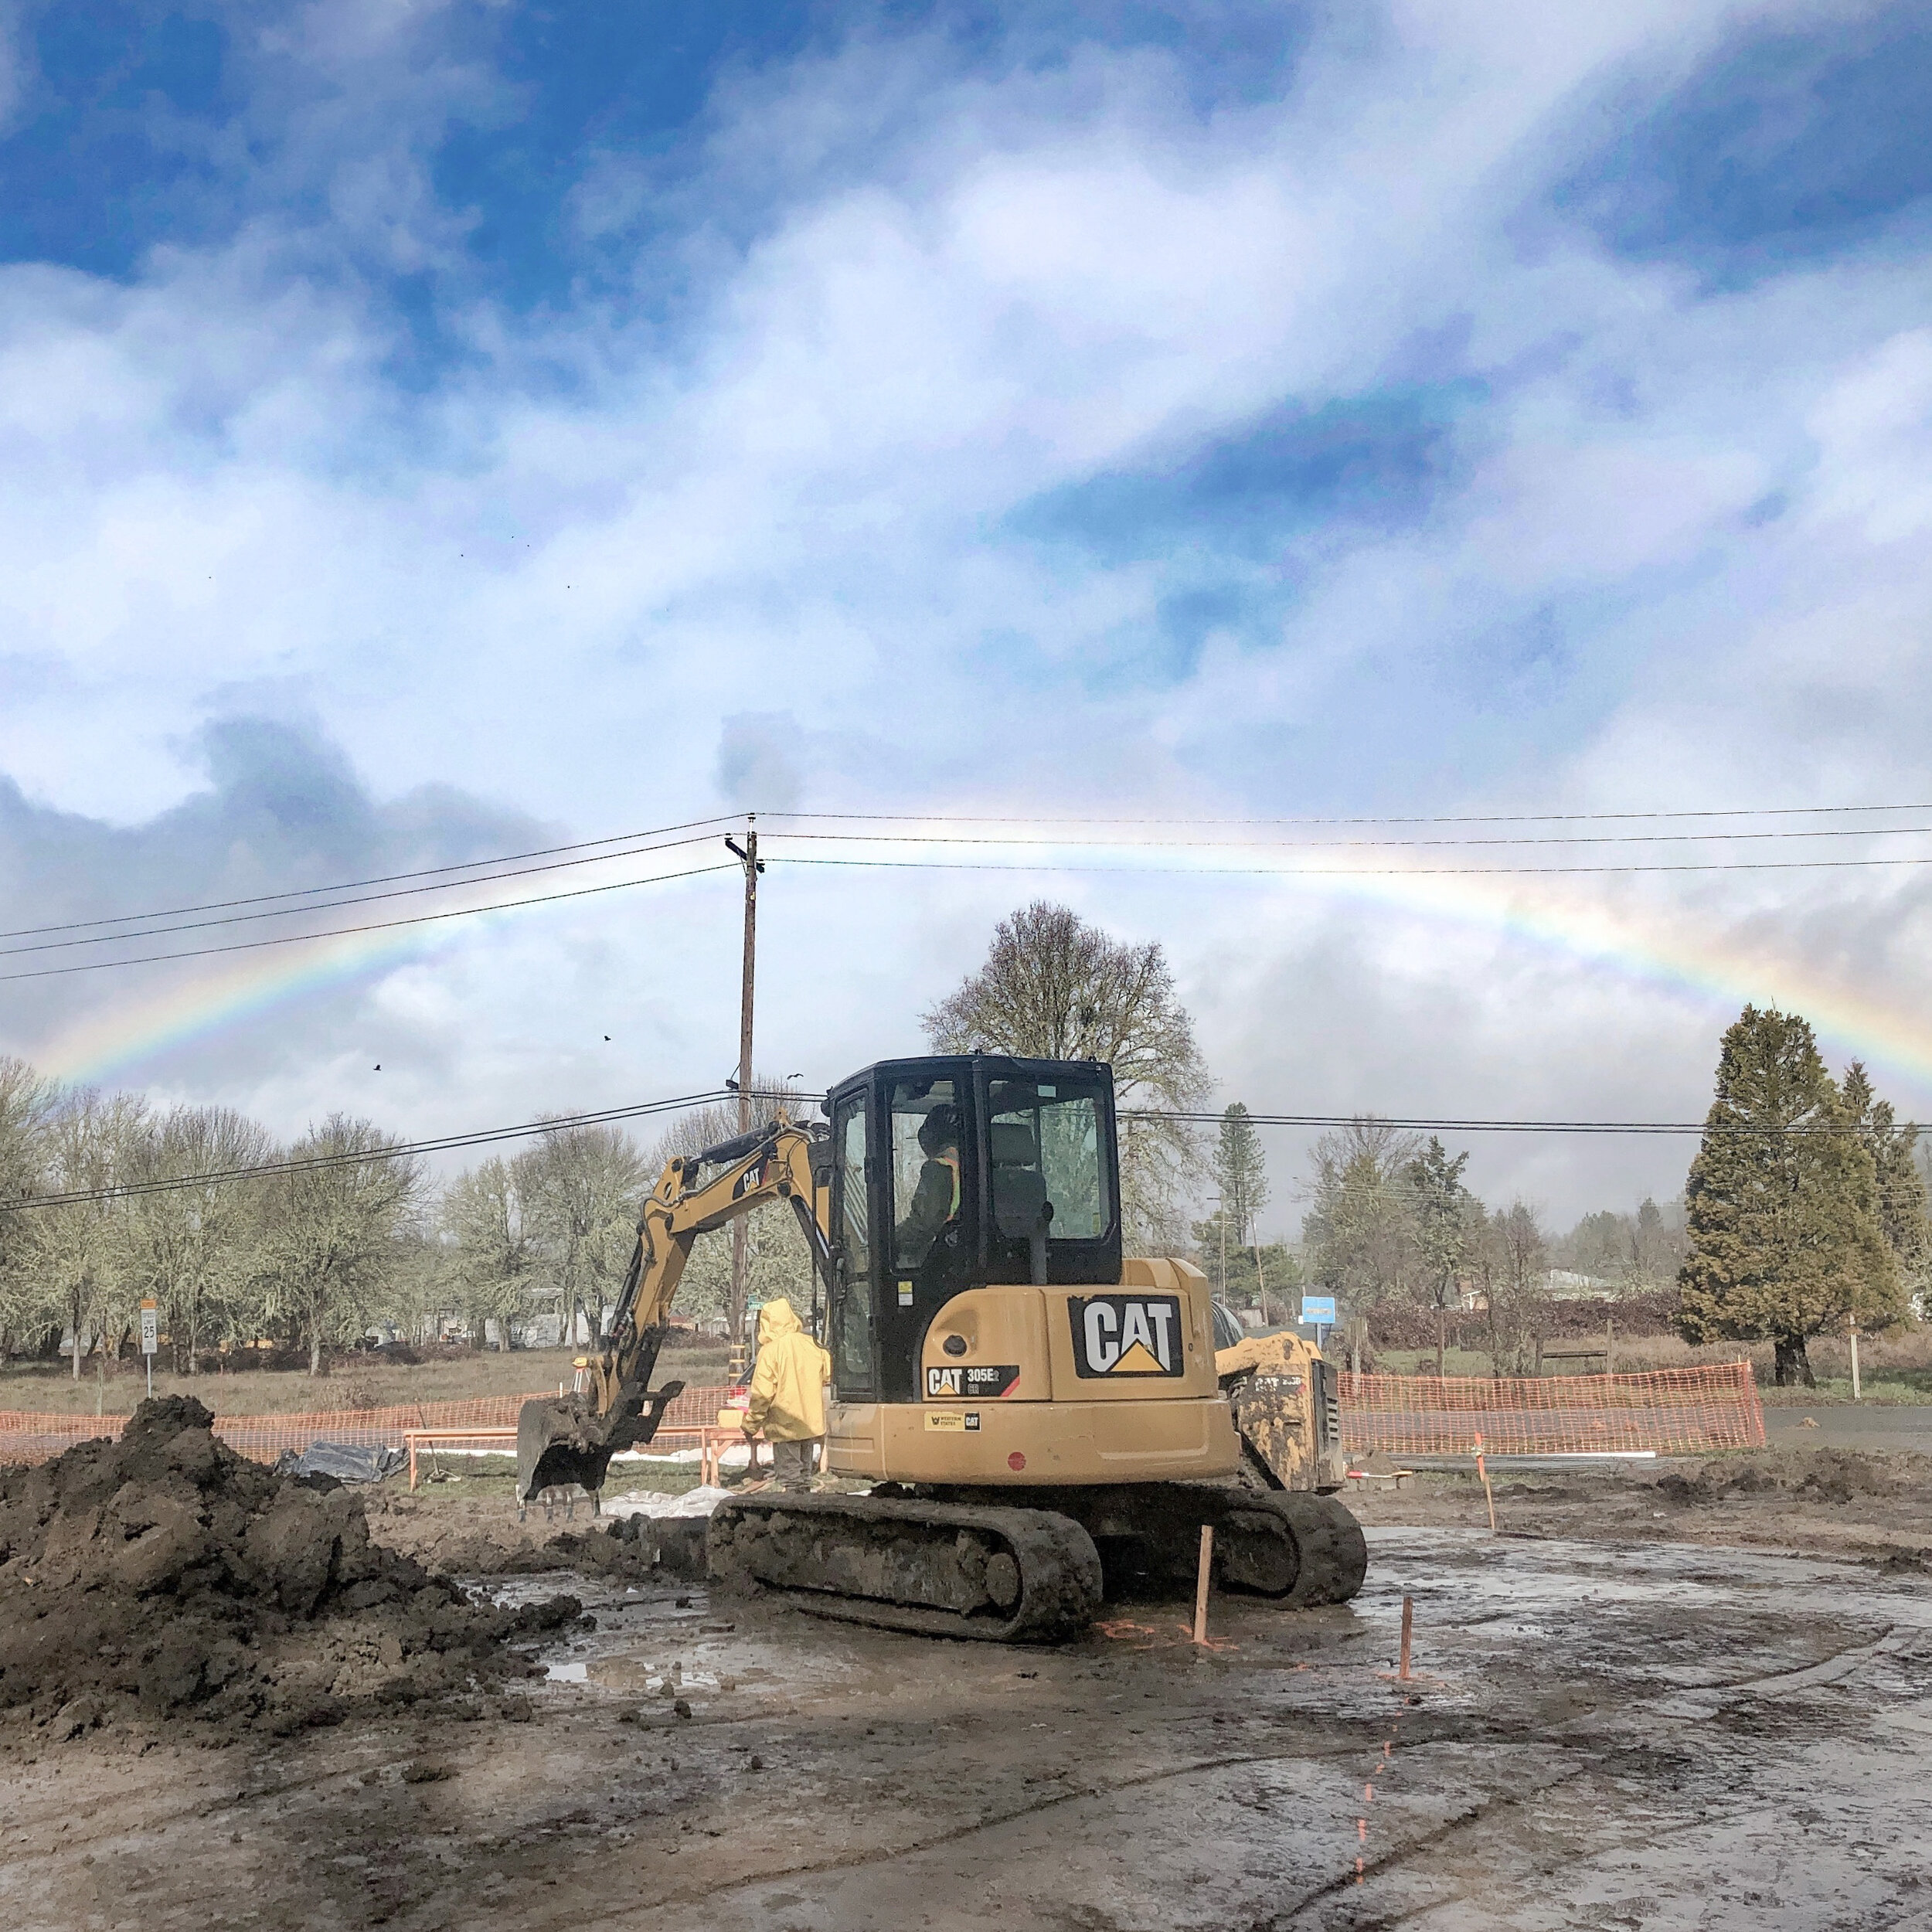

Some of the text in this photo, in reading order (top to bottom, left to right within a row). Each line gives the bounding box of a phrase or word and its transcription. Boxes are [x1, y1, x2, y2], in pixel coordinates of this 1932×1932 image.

[743, 1167, 760, 1192] CAT
[144, 1325, 155, 1338] 25
[1083, 1301, 1172, 1372] CAT
[928, 1368, 962, 1395] CAT
[965, 1417, 978, 1427] CAT
